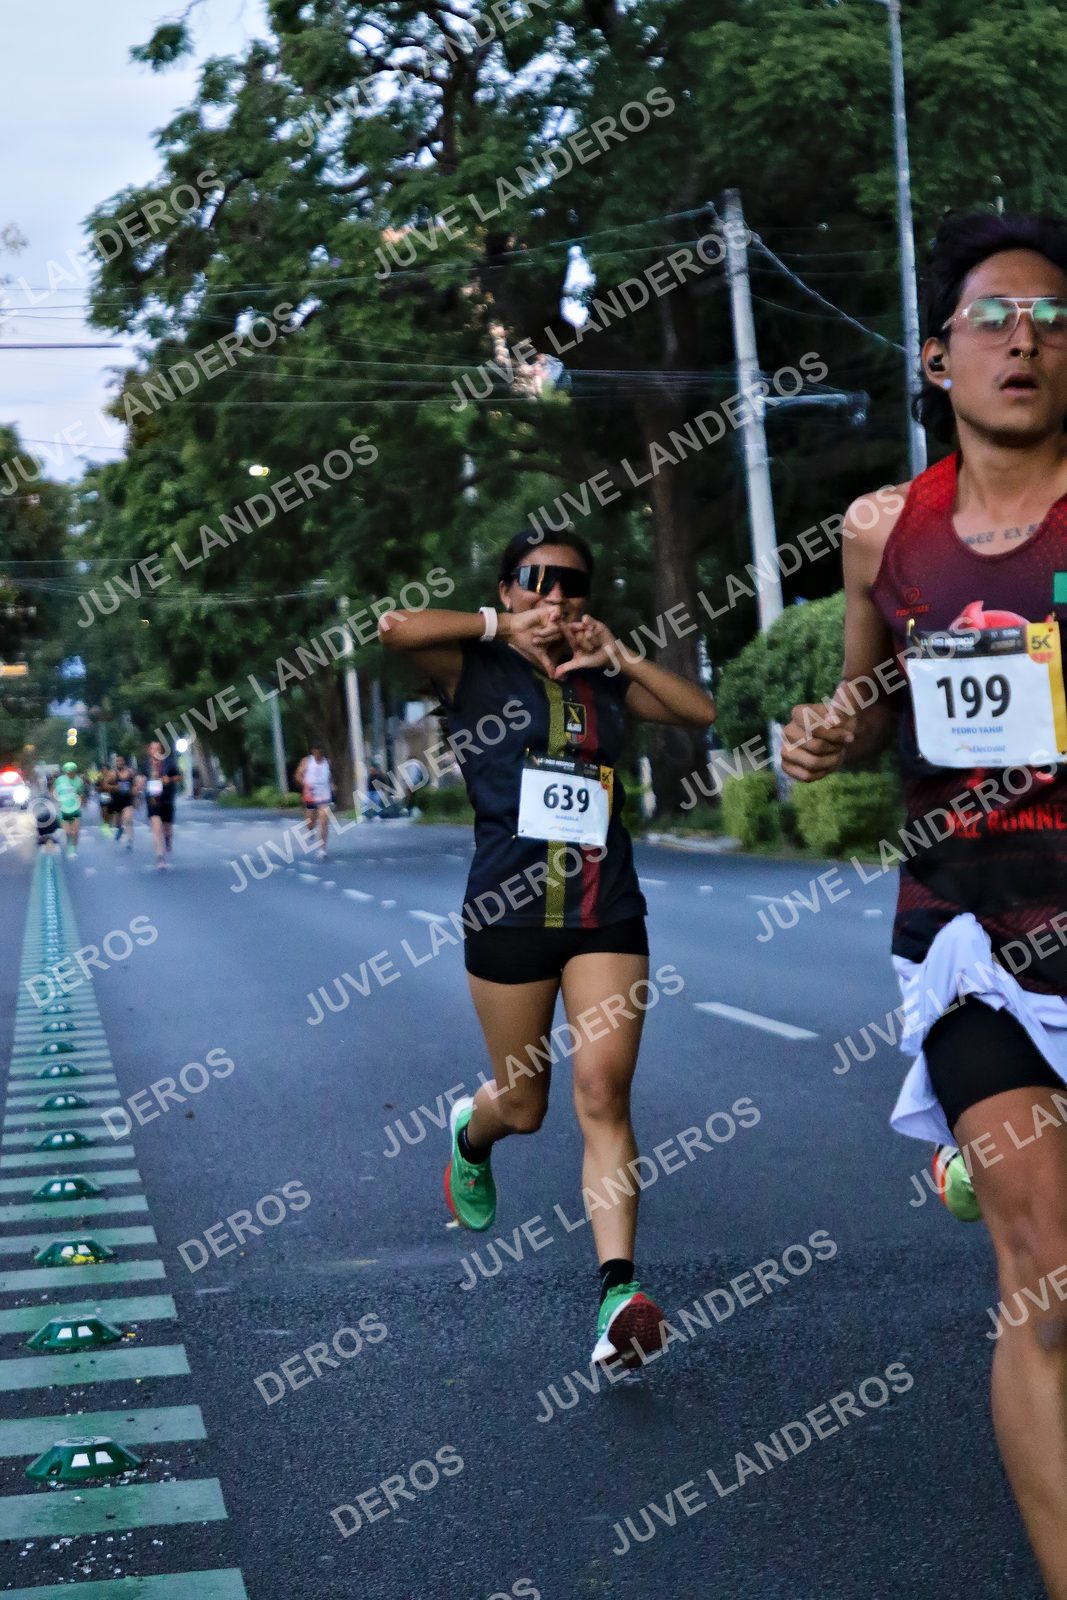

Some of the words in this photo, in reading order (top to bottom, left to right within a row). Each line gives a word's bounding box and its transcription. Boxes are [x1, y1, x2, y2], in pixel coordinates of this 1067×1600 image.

[1031, 634, 1052, 650] 5K
[936, 673, 1011, 719] 199
[543, 783, 590, 813] 639
